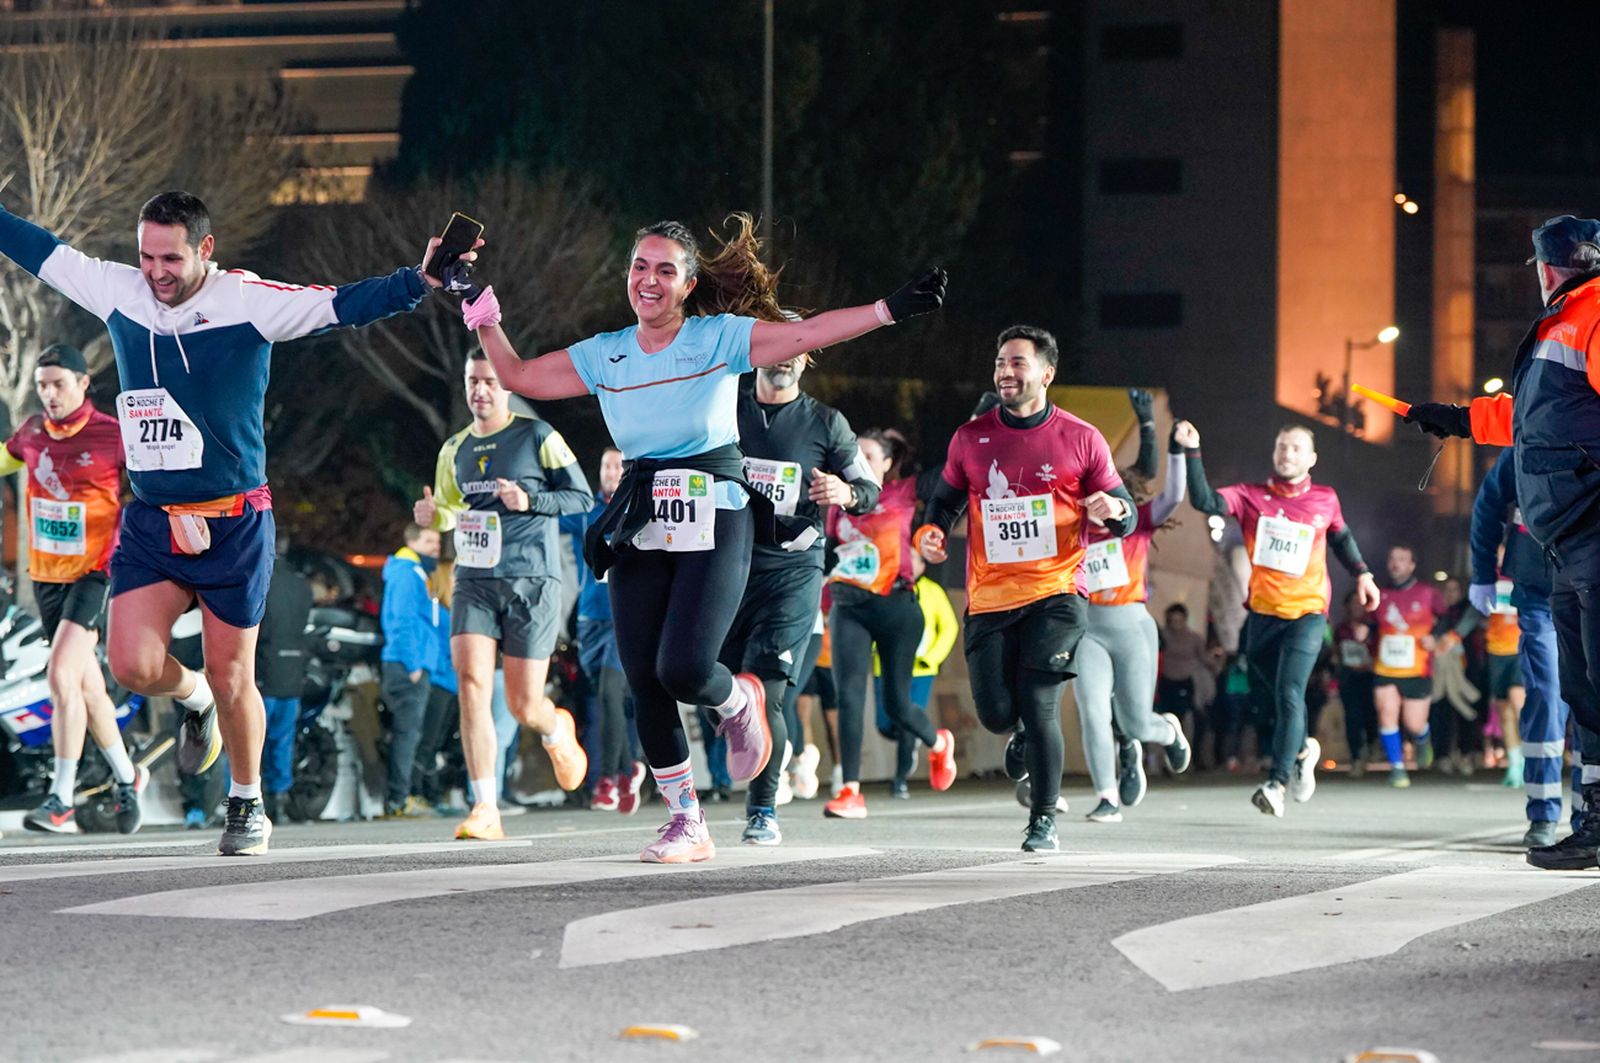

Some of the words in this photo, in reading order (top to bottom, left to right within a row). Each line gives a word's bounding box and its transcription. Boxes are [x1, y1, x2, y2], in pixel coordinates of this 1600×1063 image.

[136, 398, 158, 407] NOCHE
[128, 409, 142, 418] SAN
[139, 418, 183, 443] 2774
[670, 478, 681, 486] DE
[38, 518, 79, 537] 12652
[998, 520, 1039, 541] 3911
[1269, 536, 1298, 554] 7041
